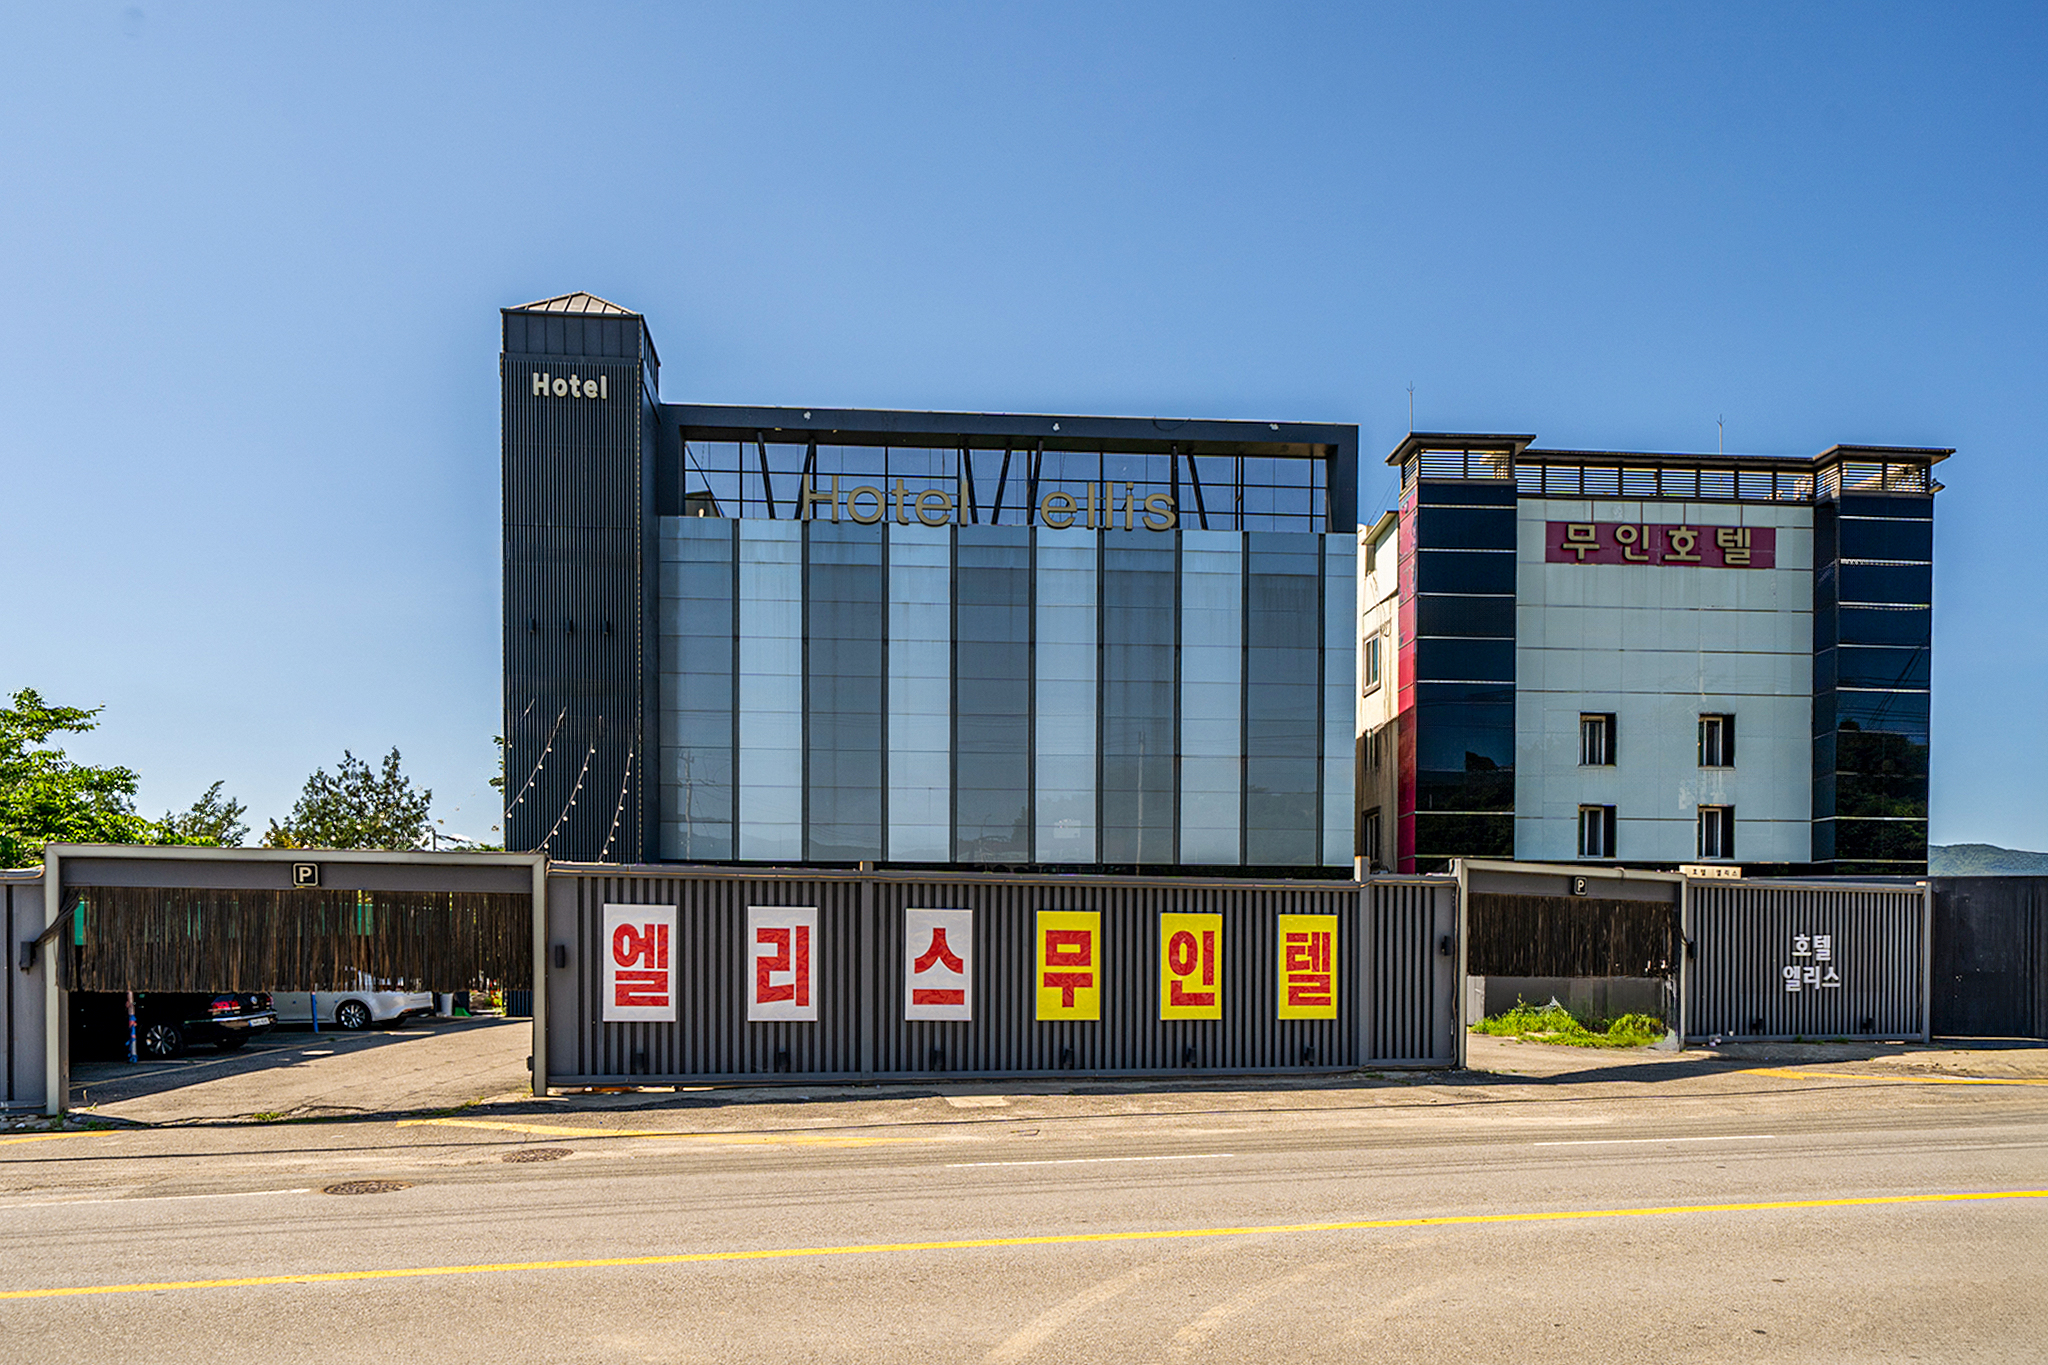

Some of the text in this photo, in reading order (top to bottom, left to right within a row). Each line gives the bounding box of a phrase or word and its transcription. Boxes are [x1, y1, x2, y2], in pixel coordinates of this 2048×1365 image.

[532, 371, 608, 400] Hotel
[802, 473, 1177, 531] Hotel ellis
[1561, 523, 1751, 566] 무인호텔
[298, 866, 313, 882] P
[1791, 933, 1831, 961] 호텔
[1782, 965, 1841, 992] 엘리스
